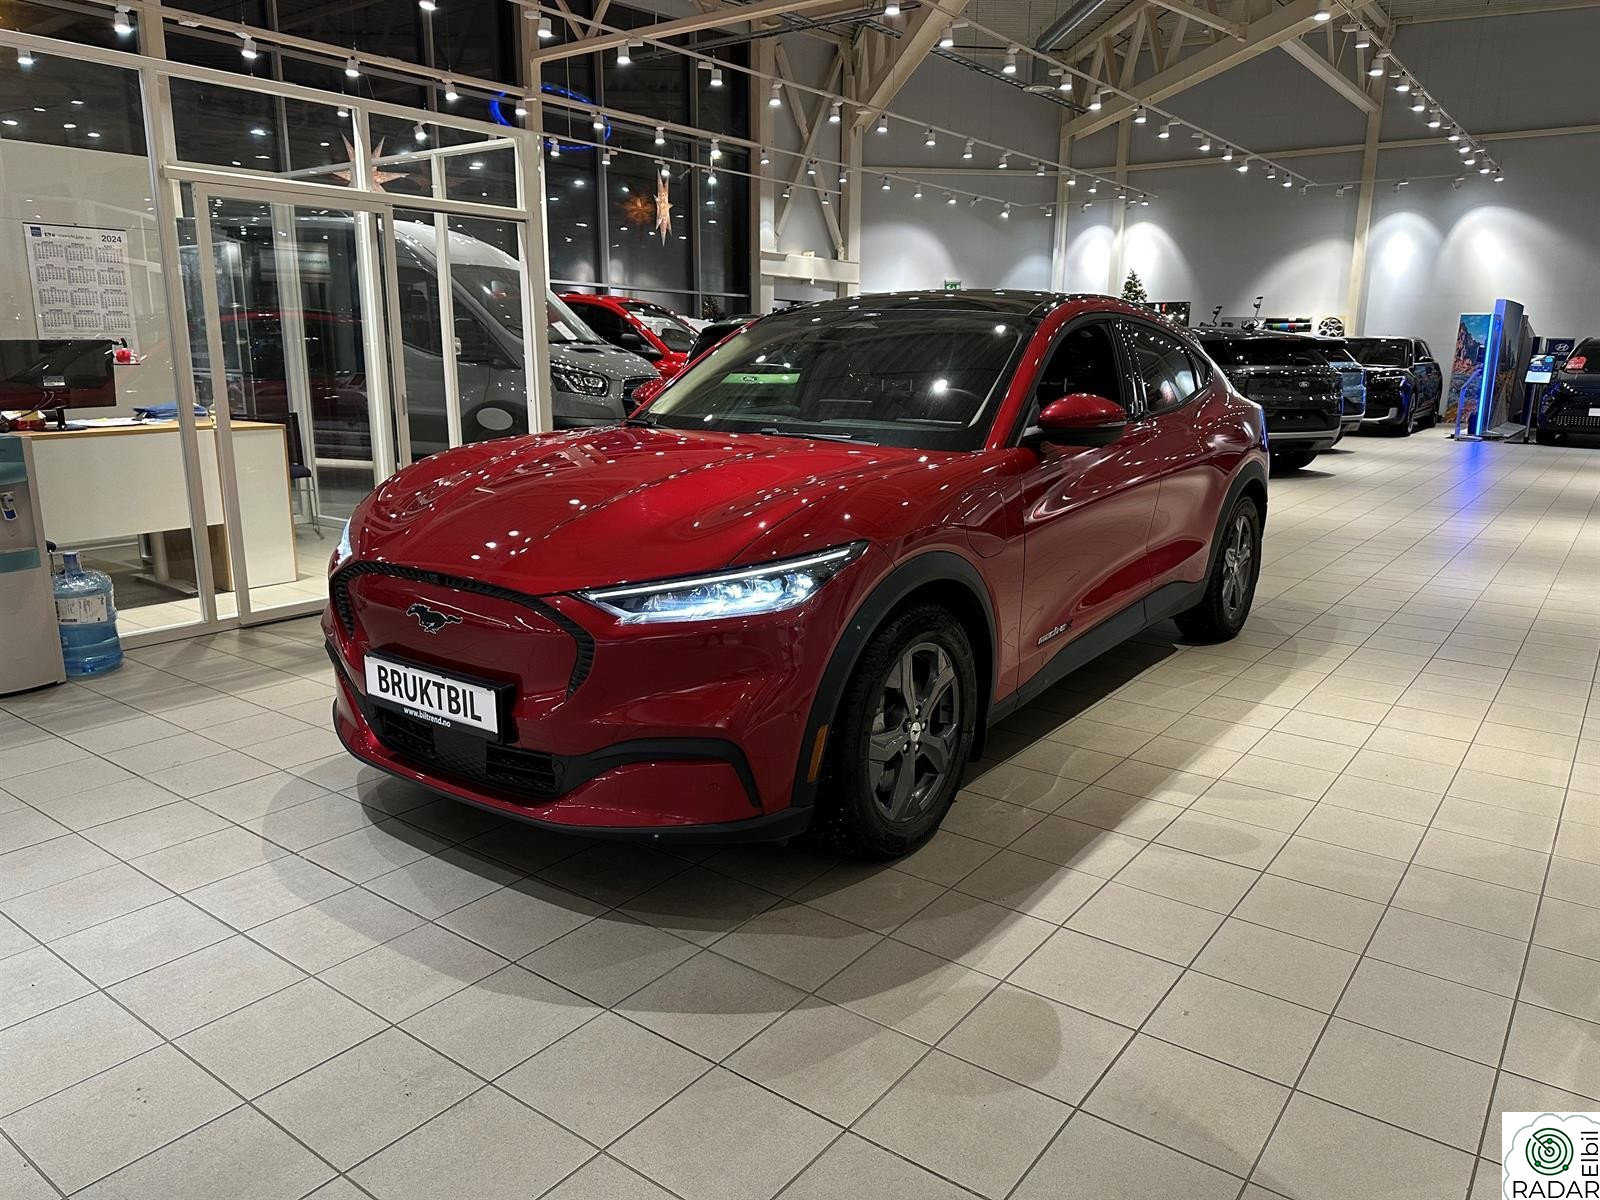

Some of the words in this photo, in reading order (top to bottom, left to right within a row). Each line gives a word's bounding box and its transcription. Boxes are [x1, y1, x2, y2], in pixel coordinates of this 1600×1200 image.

[101, 234, 122, 243] 2024
[377, 665, 482, 722] BRUKTBIL
[403, 706, 451, 728] www.biltrend.no
